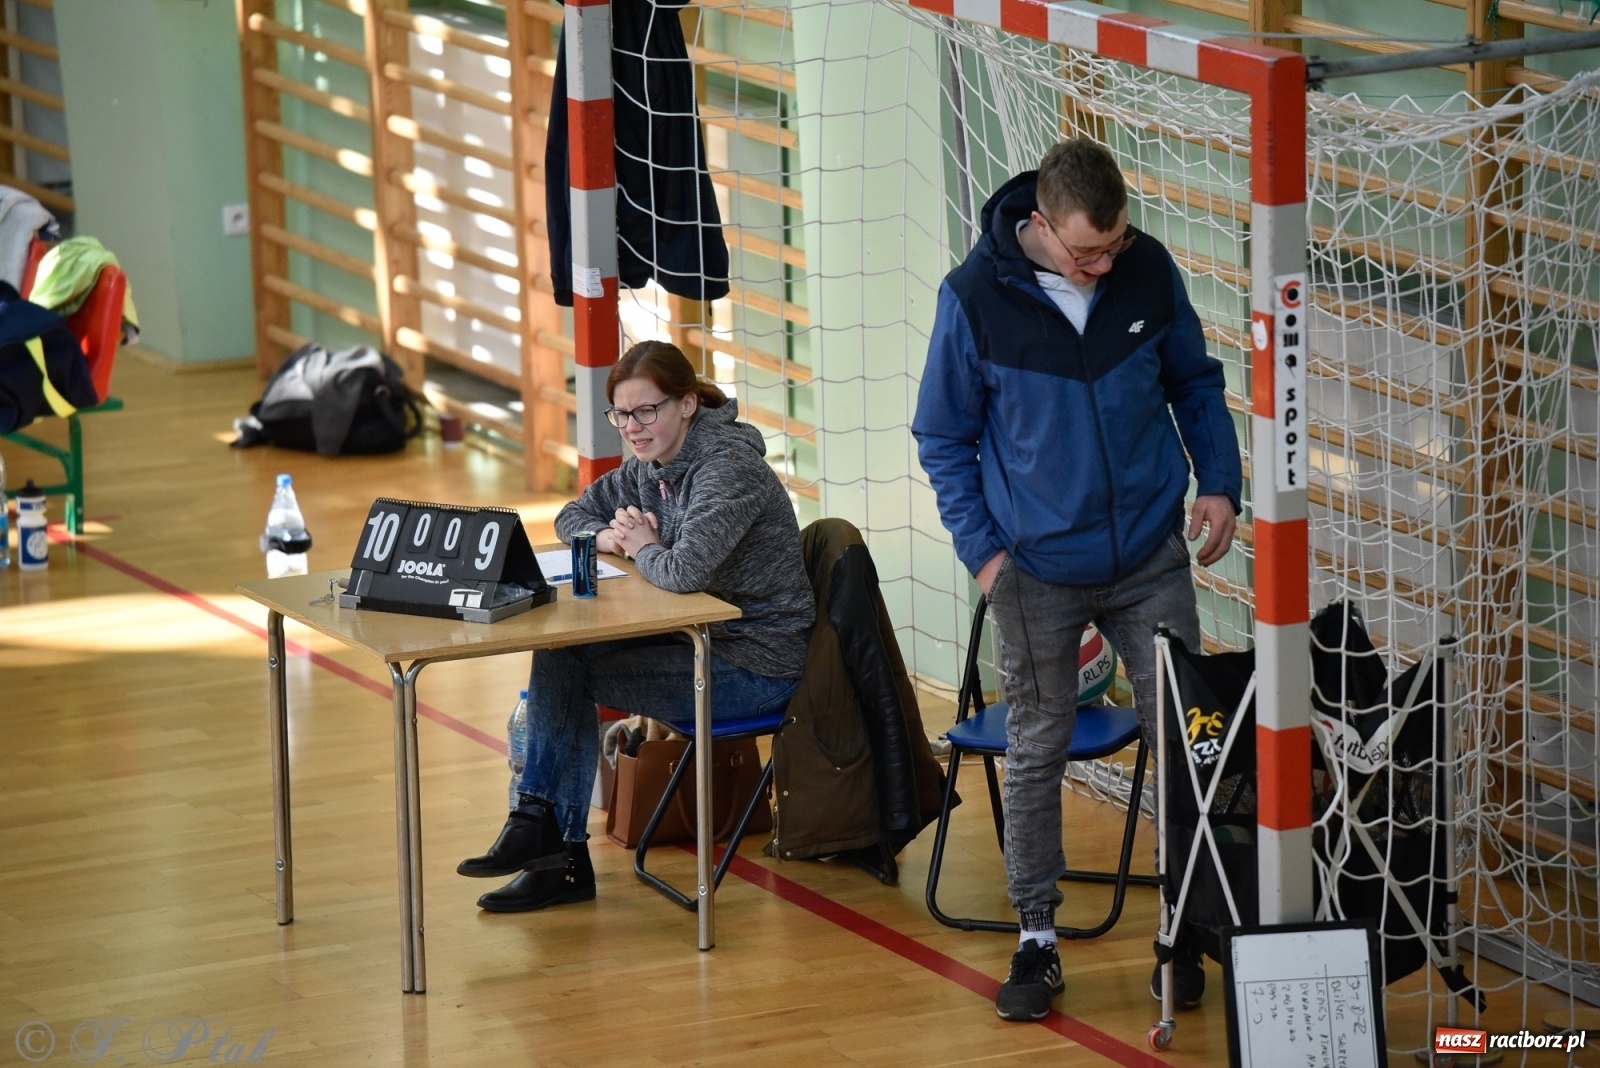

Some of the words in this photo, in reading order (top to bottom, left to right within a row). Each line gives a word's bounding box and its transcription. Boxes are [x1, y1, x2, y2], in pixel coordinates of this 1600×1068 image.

[1128, 320, 1145, 334] 4F
[1285, 387, 1298, 486] sport
[363, 511, 400, 562] 10
[413, 513, 432, 547] 0
[443, 517, 462, 551] 0
[474, 521, 500, 571] 9
[397, 559, 444, 577] JOOLA
[1083, 655, 1111, 684] RLPS
